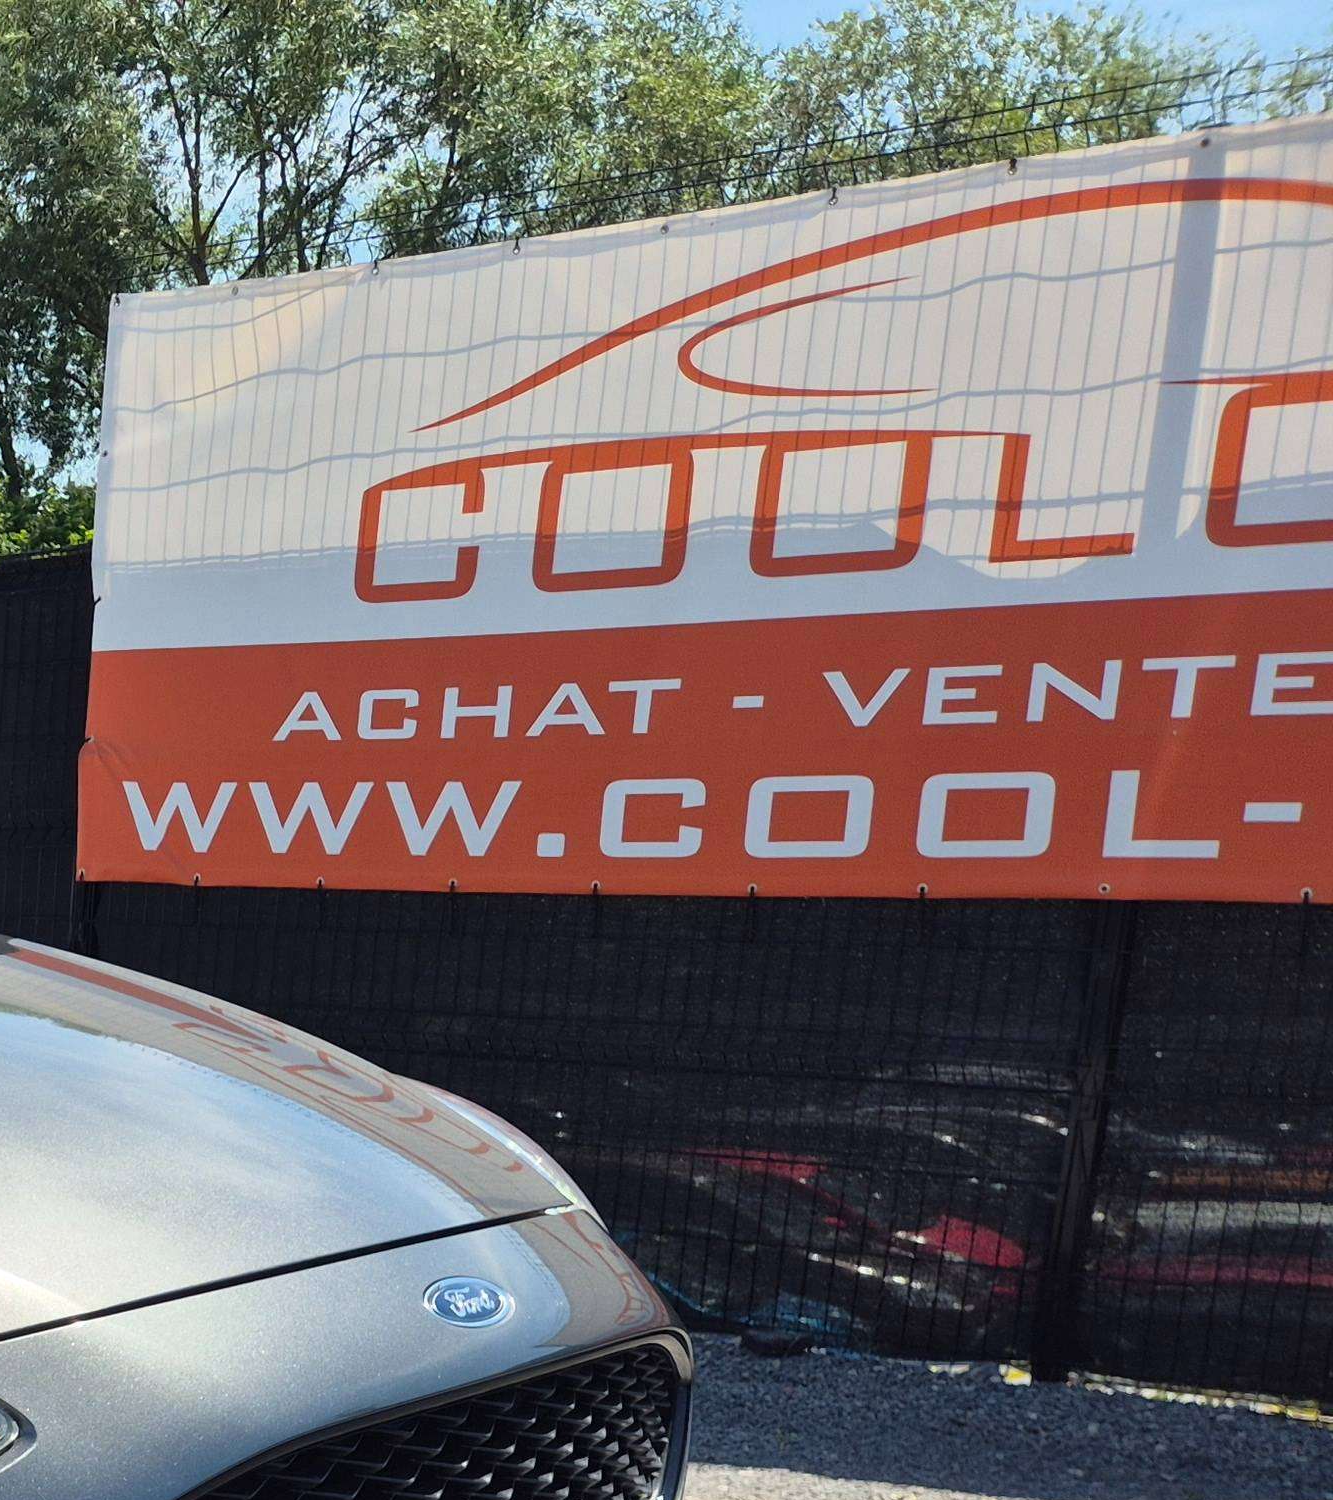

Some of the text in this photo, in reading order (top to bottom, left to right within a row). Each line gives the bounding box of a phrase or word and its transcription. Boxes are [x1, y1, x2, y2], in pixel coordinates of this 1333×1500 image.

[354, 428, 1135, 603] COOL
[271, 678, 681, 742] ACHAT
[822, 650, 1333, 728] VENTE
[121, 768, 1304, 860] WWW.COOL-
[443, 1285, 496, 1318] Ford
